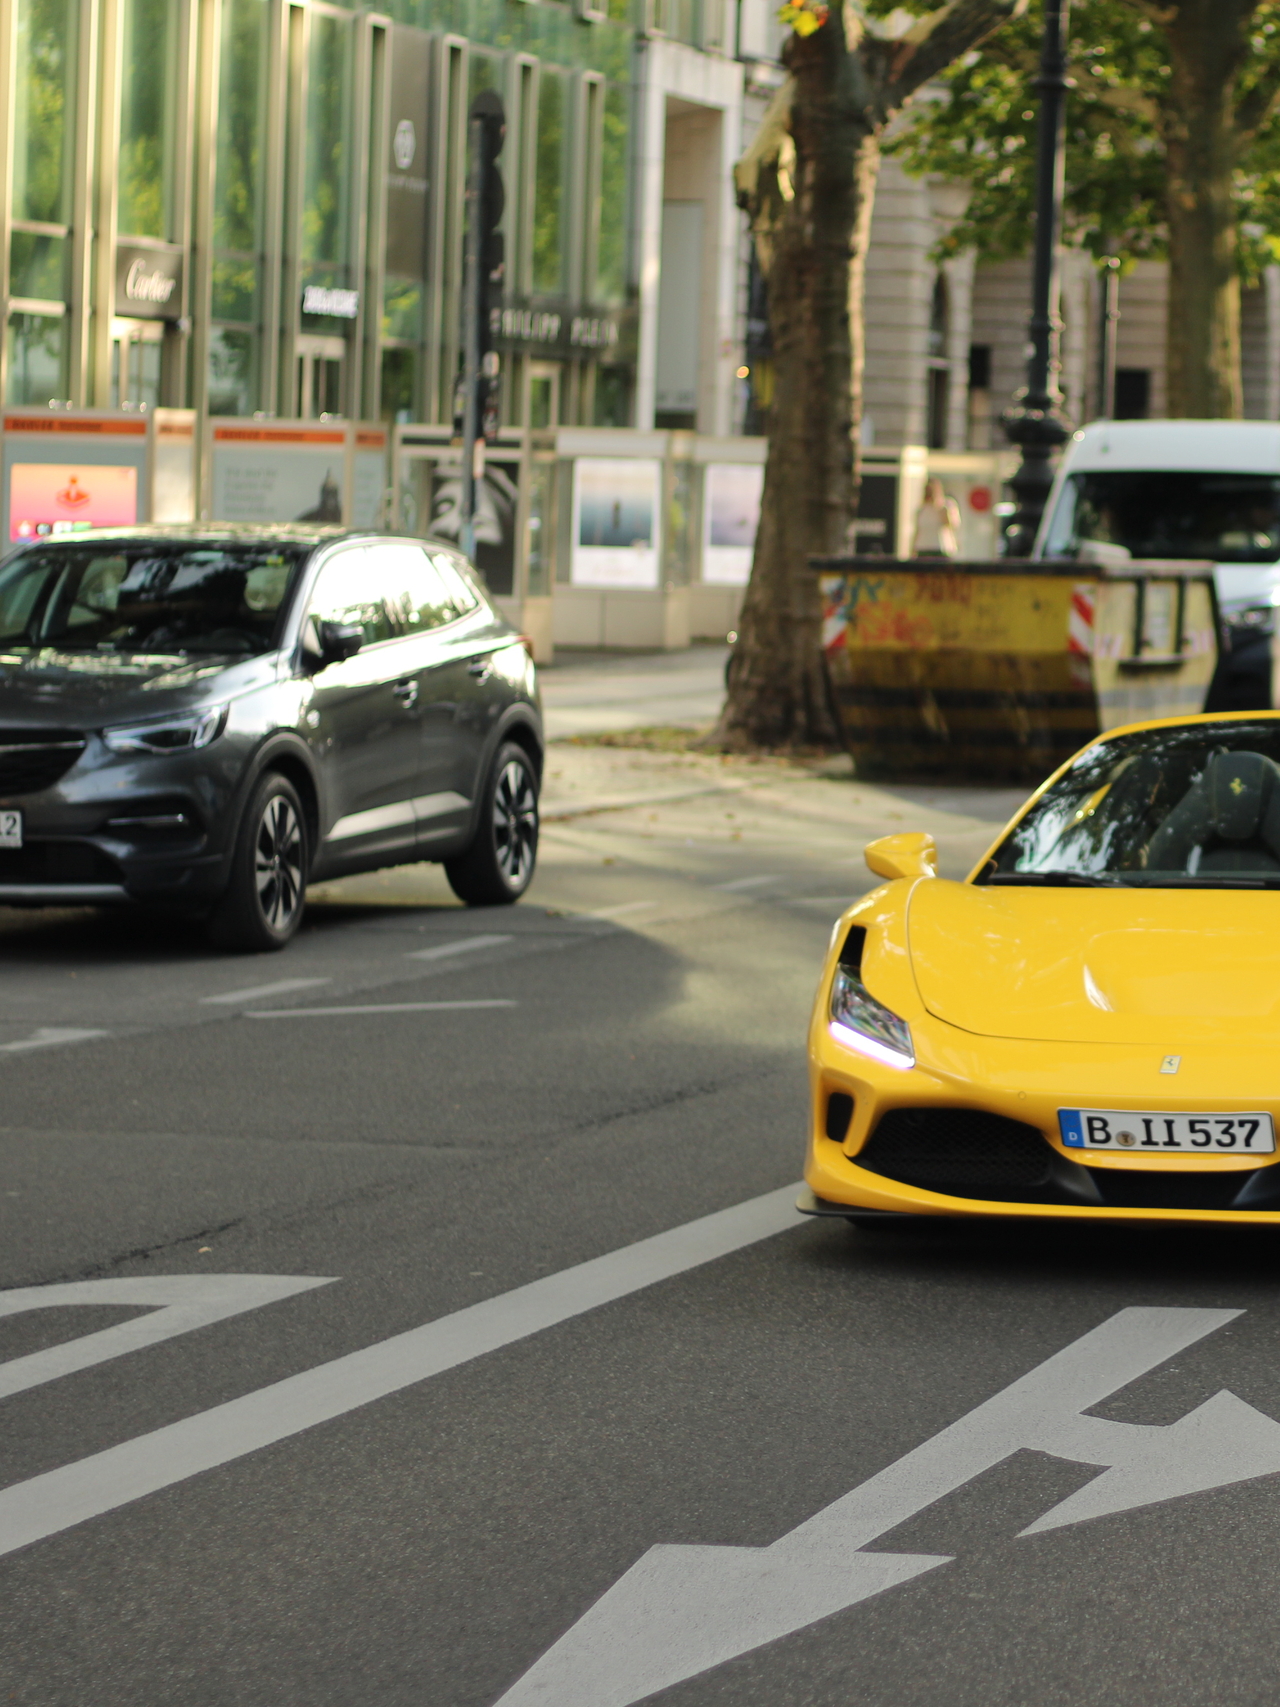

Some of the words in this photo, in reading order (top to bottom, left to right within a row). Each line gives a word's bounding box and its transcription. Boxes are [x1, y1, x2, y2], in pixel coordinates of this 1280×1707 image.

[126, 258, 176, 303] Cartier
[1069, 1132, 1078, 1141] D
[1086, 1116, 1112, 1144] B
[1188, 1119, 1260, 1148] 537
